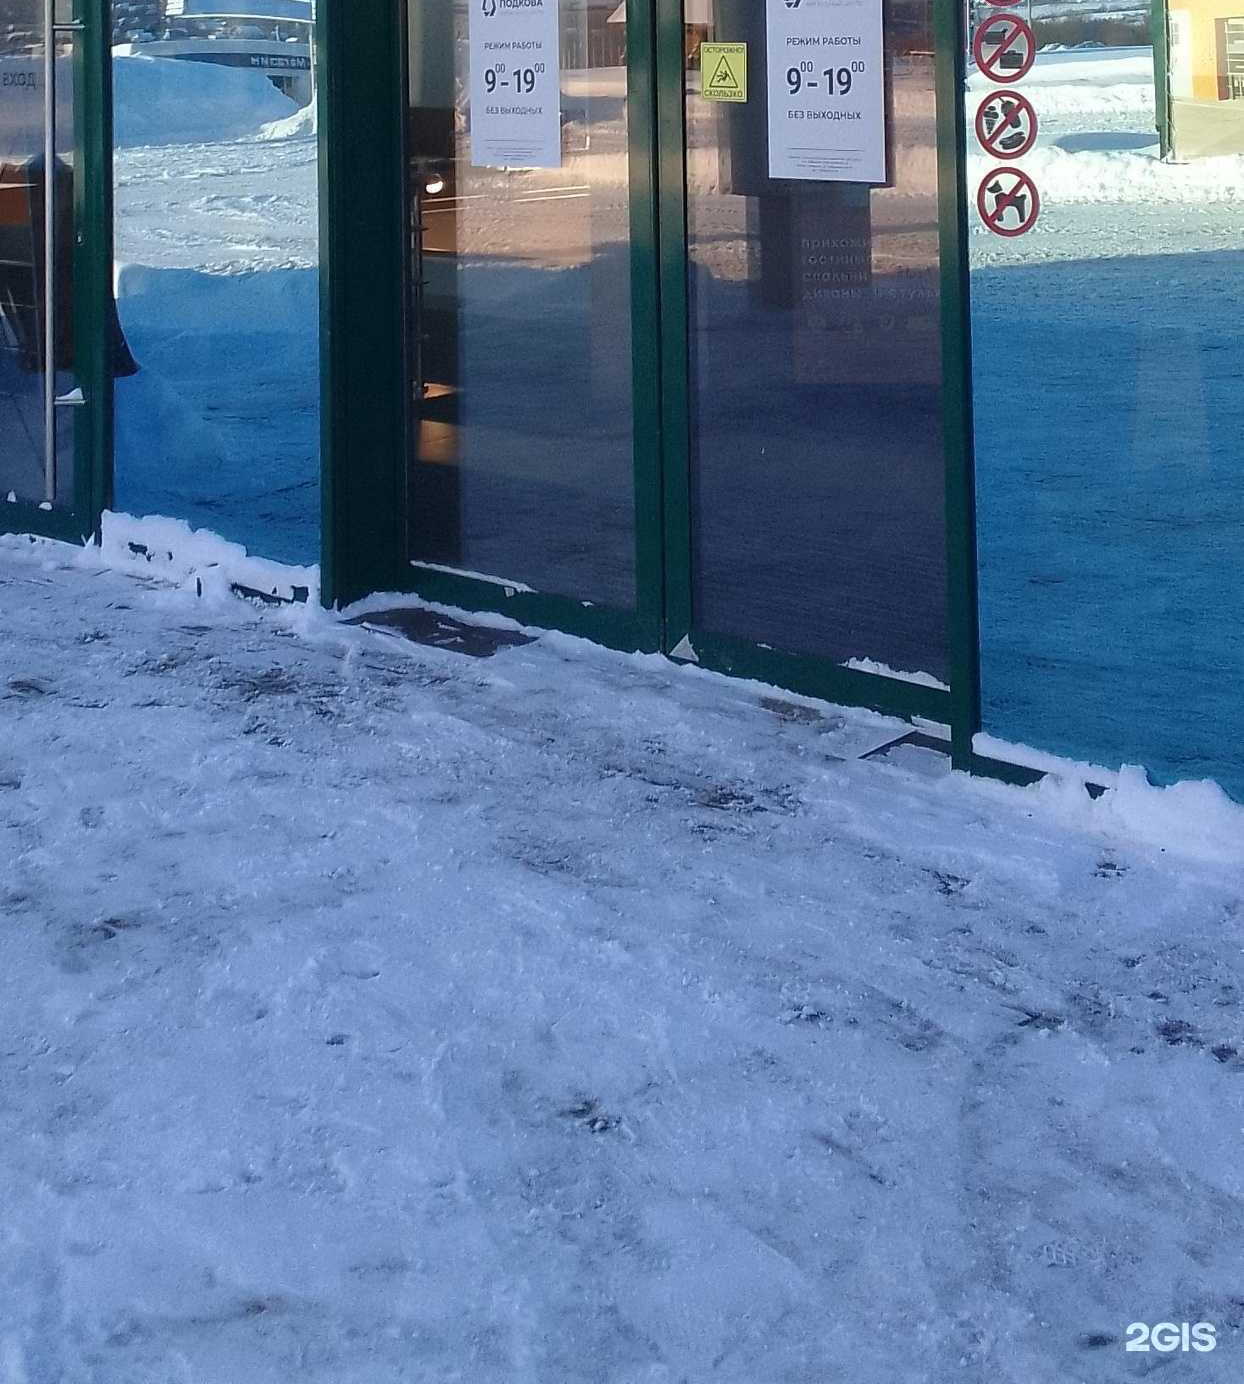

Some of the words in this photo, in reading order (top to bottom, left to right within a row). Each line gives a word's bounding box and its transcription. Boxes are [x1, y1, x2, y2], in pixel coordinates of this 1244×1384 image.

[484, 41, 511, 50] РЕЖИМ
[512, 40, 543, 50] РАБОТЫ
[786, 36, 821, 47] РЕЖИМ
[822, 35, 862, 47] РАБОТЫ
[485, 105, 499, 115] БЕЗ
[787, 110, 805, 120] БЕЗ
[806, 110, 862, 121] ВЫХОДНЫХ
